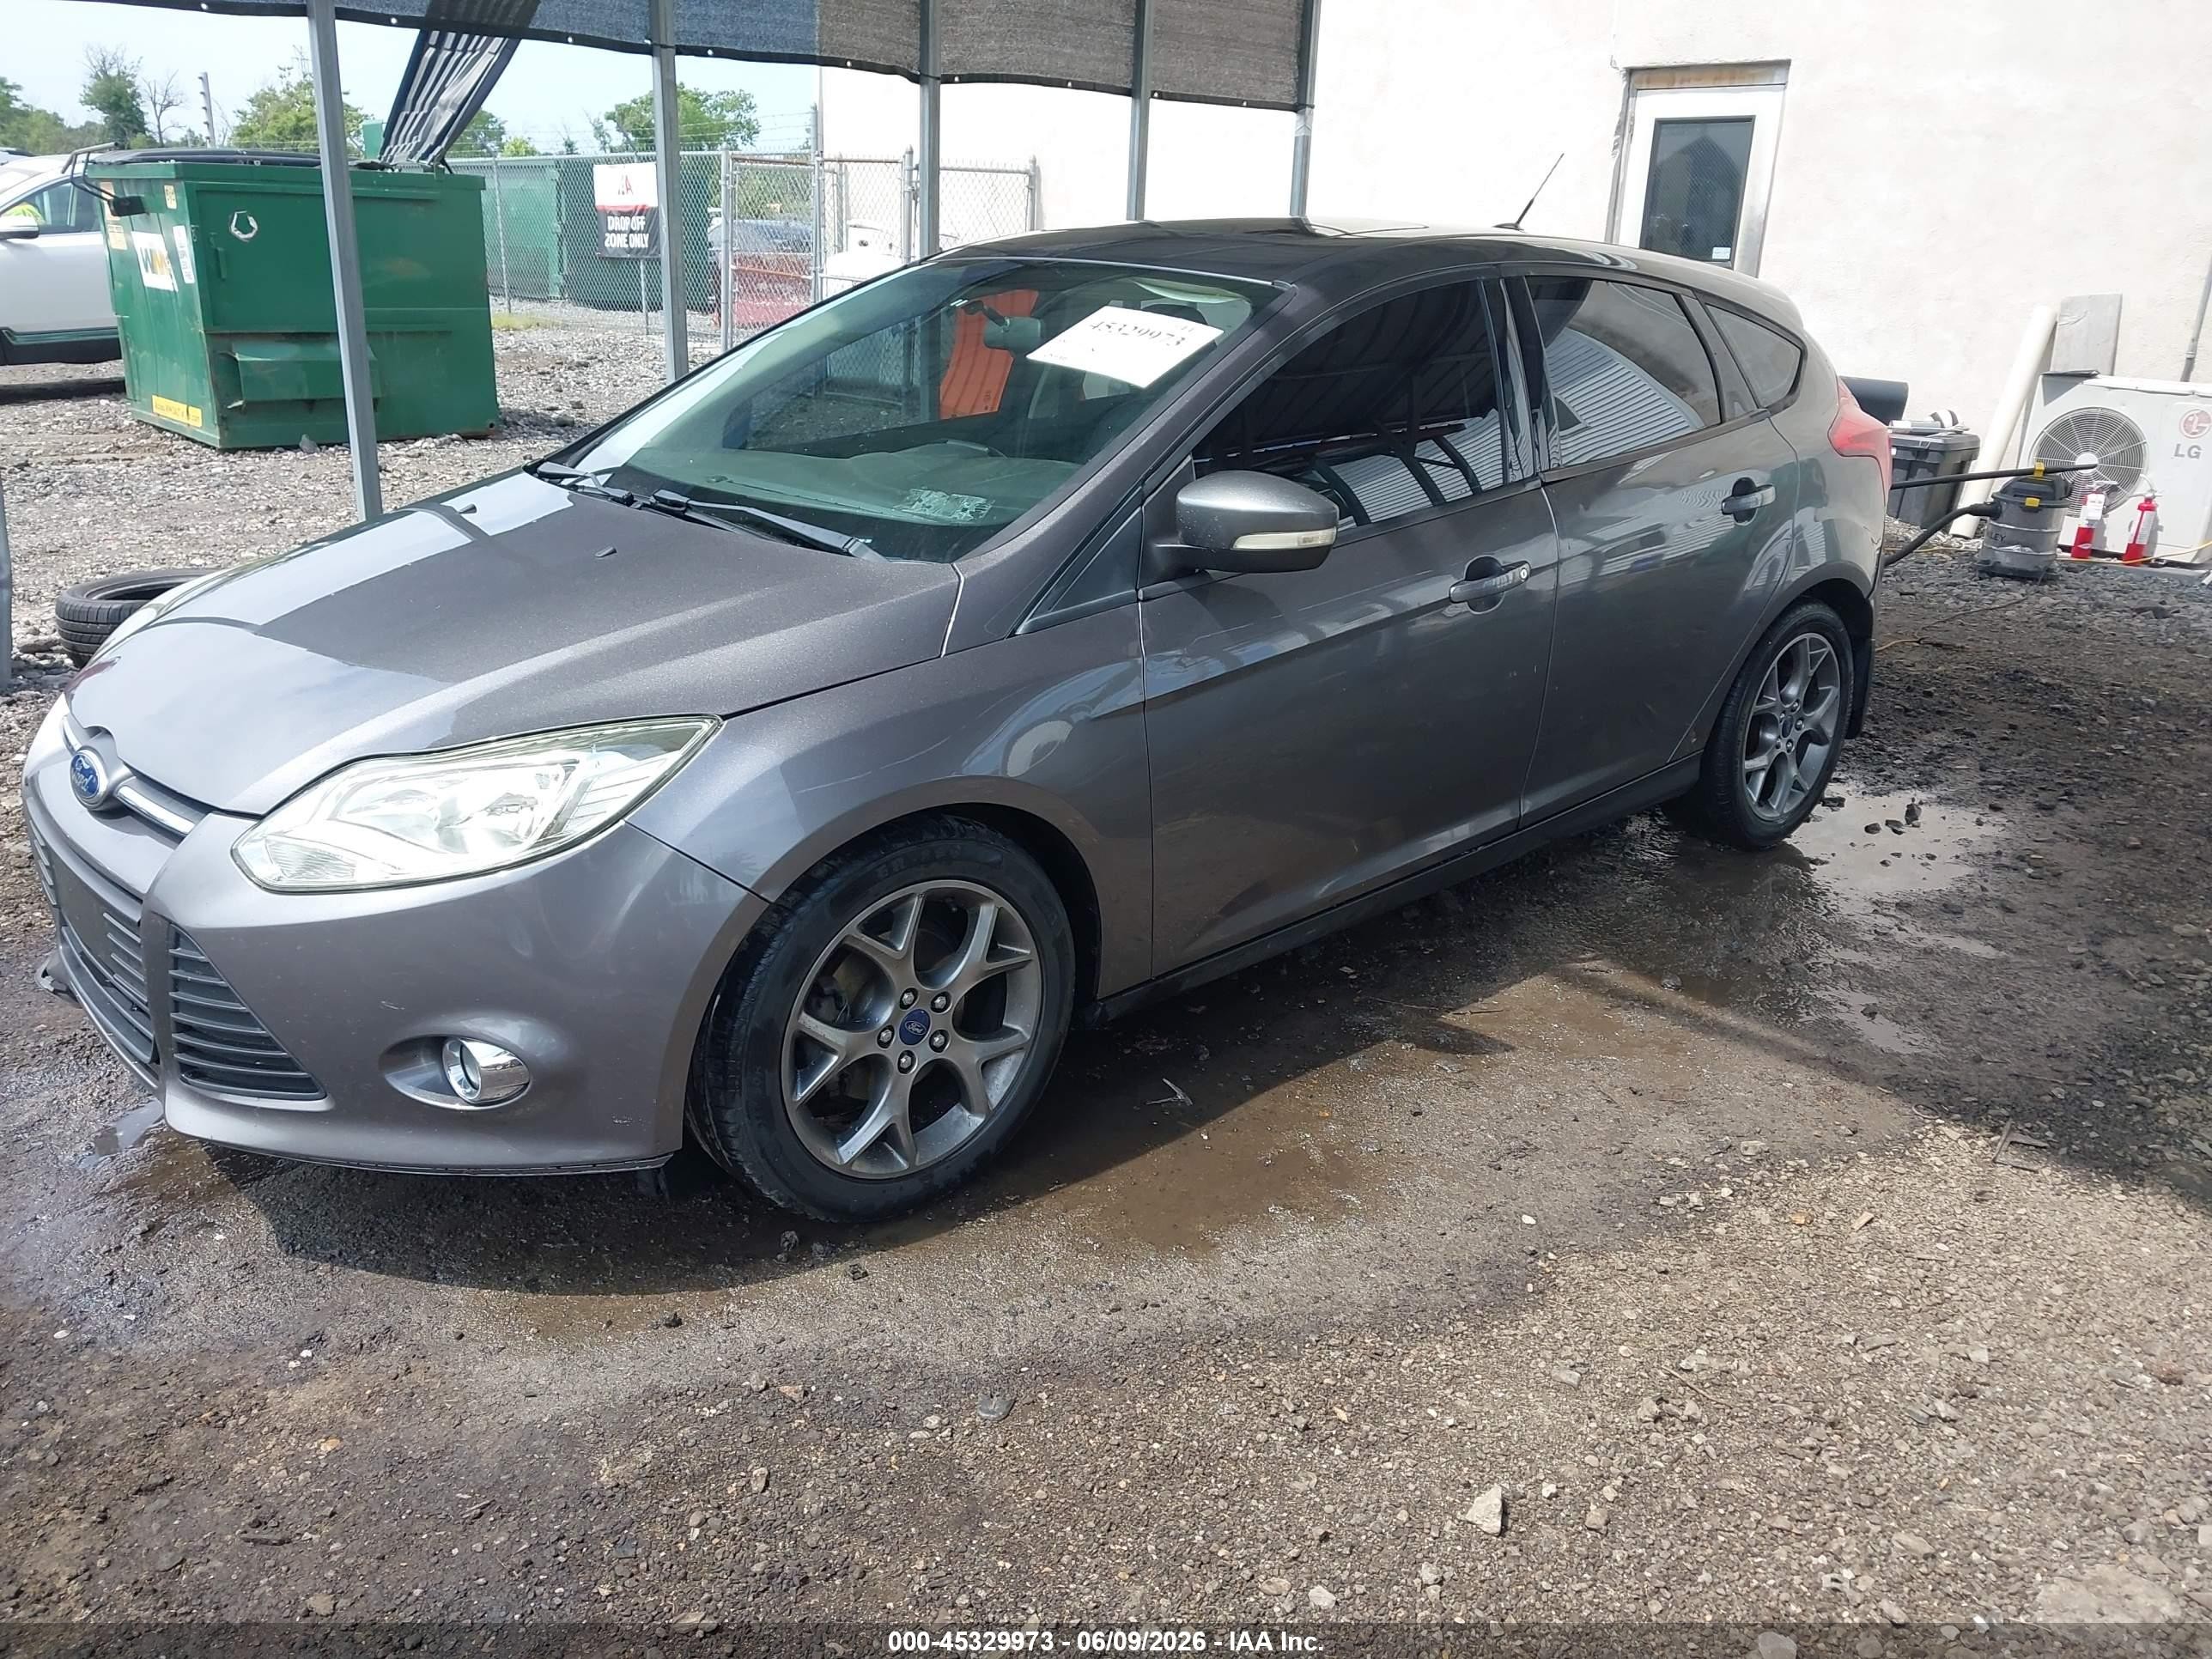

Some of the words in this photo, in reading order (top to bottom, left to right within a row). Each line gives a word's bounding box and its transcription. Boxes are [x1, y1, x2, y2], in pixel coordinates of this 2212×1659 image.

[607, 216, 630, 231] DROP
[631, 215, 646, 231] OFF
[605, 233, 629, 248] ZONE
[629, 233, 649, 248] ONLY
[2173, 443, 2203, 459] LG
[72, 757, 96, 792] Ford
[908, 1022, 923, 1033] Ford
